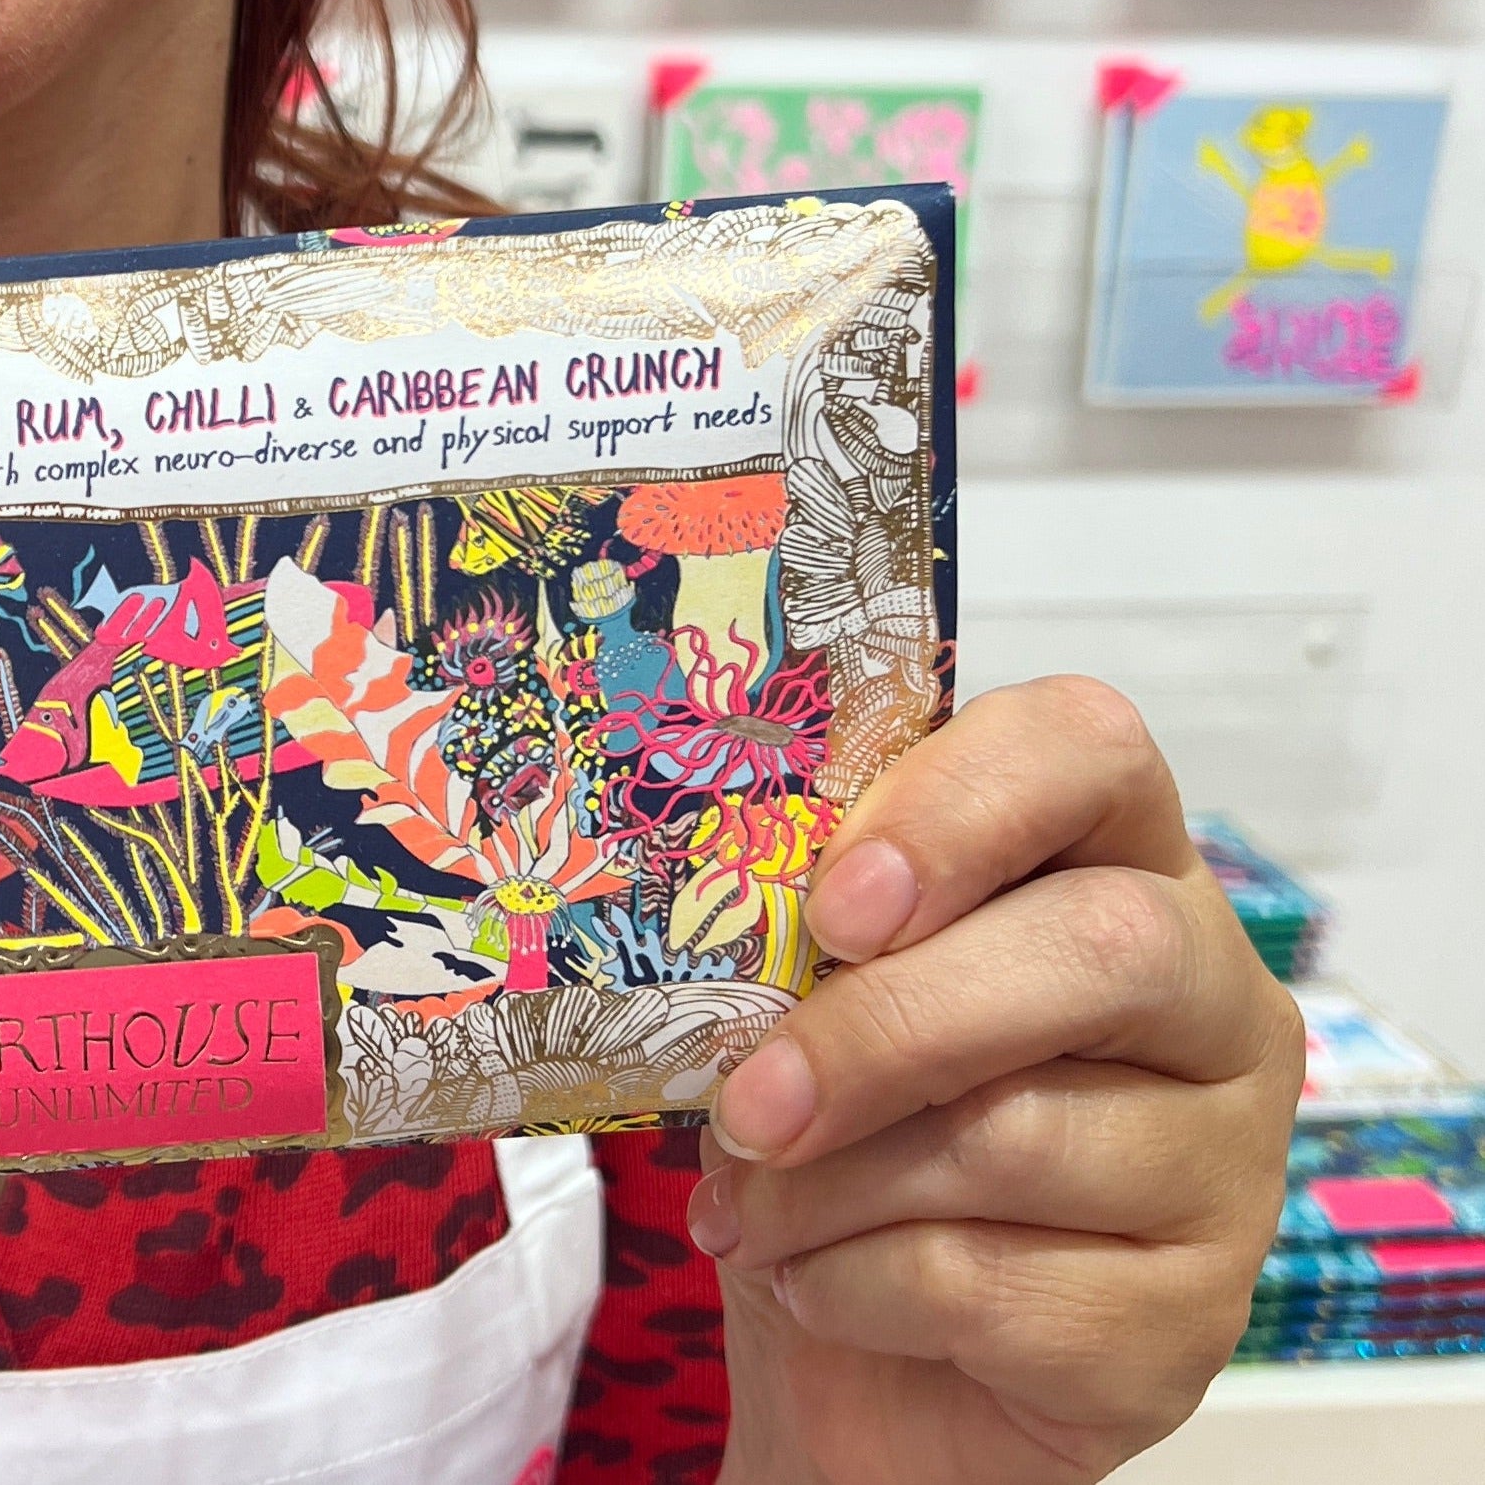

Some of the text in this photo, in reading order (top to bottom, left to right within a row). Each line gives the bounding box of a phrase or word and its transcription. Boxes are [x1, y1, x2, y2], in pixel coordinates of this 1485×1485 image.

[16, 396, 125, 452] RUM,
[144, 383, 279, 434] CHILLI
[293, 397, 313, 417] &
[328, 360, 541, 419] CARIBBEAN
[564, 346, 724, 402] CRUNCH
[34, 448, 140, 498] complex
[154, 431, 358, 474] neuro-diverse
[373, 419, 424, 455] and
[442, 414, 551, 471] physical
[568, 401, 677, 458] support
[693, 391, 772, 431] needs
